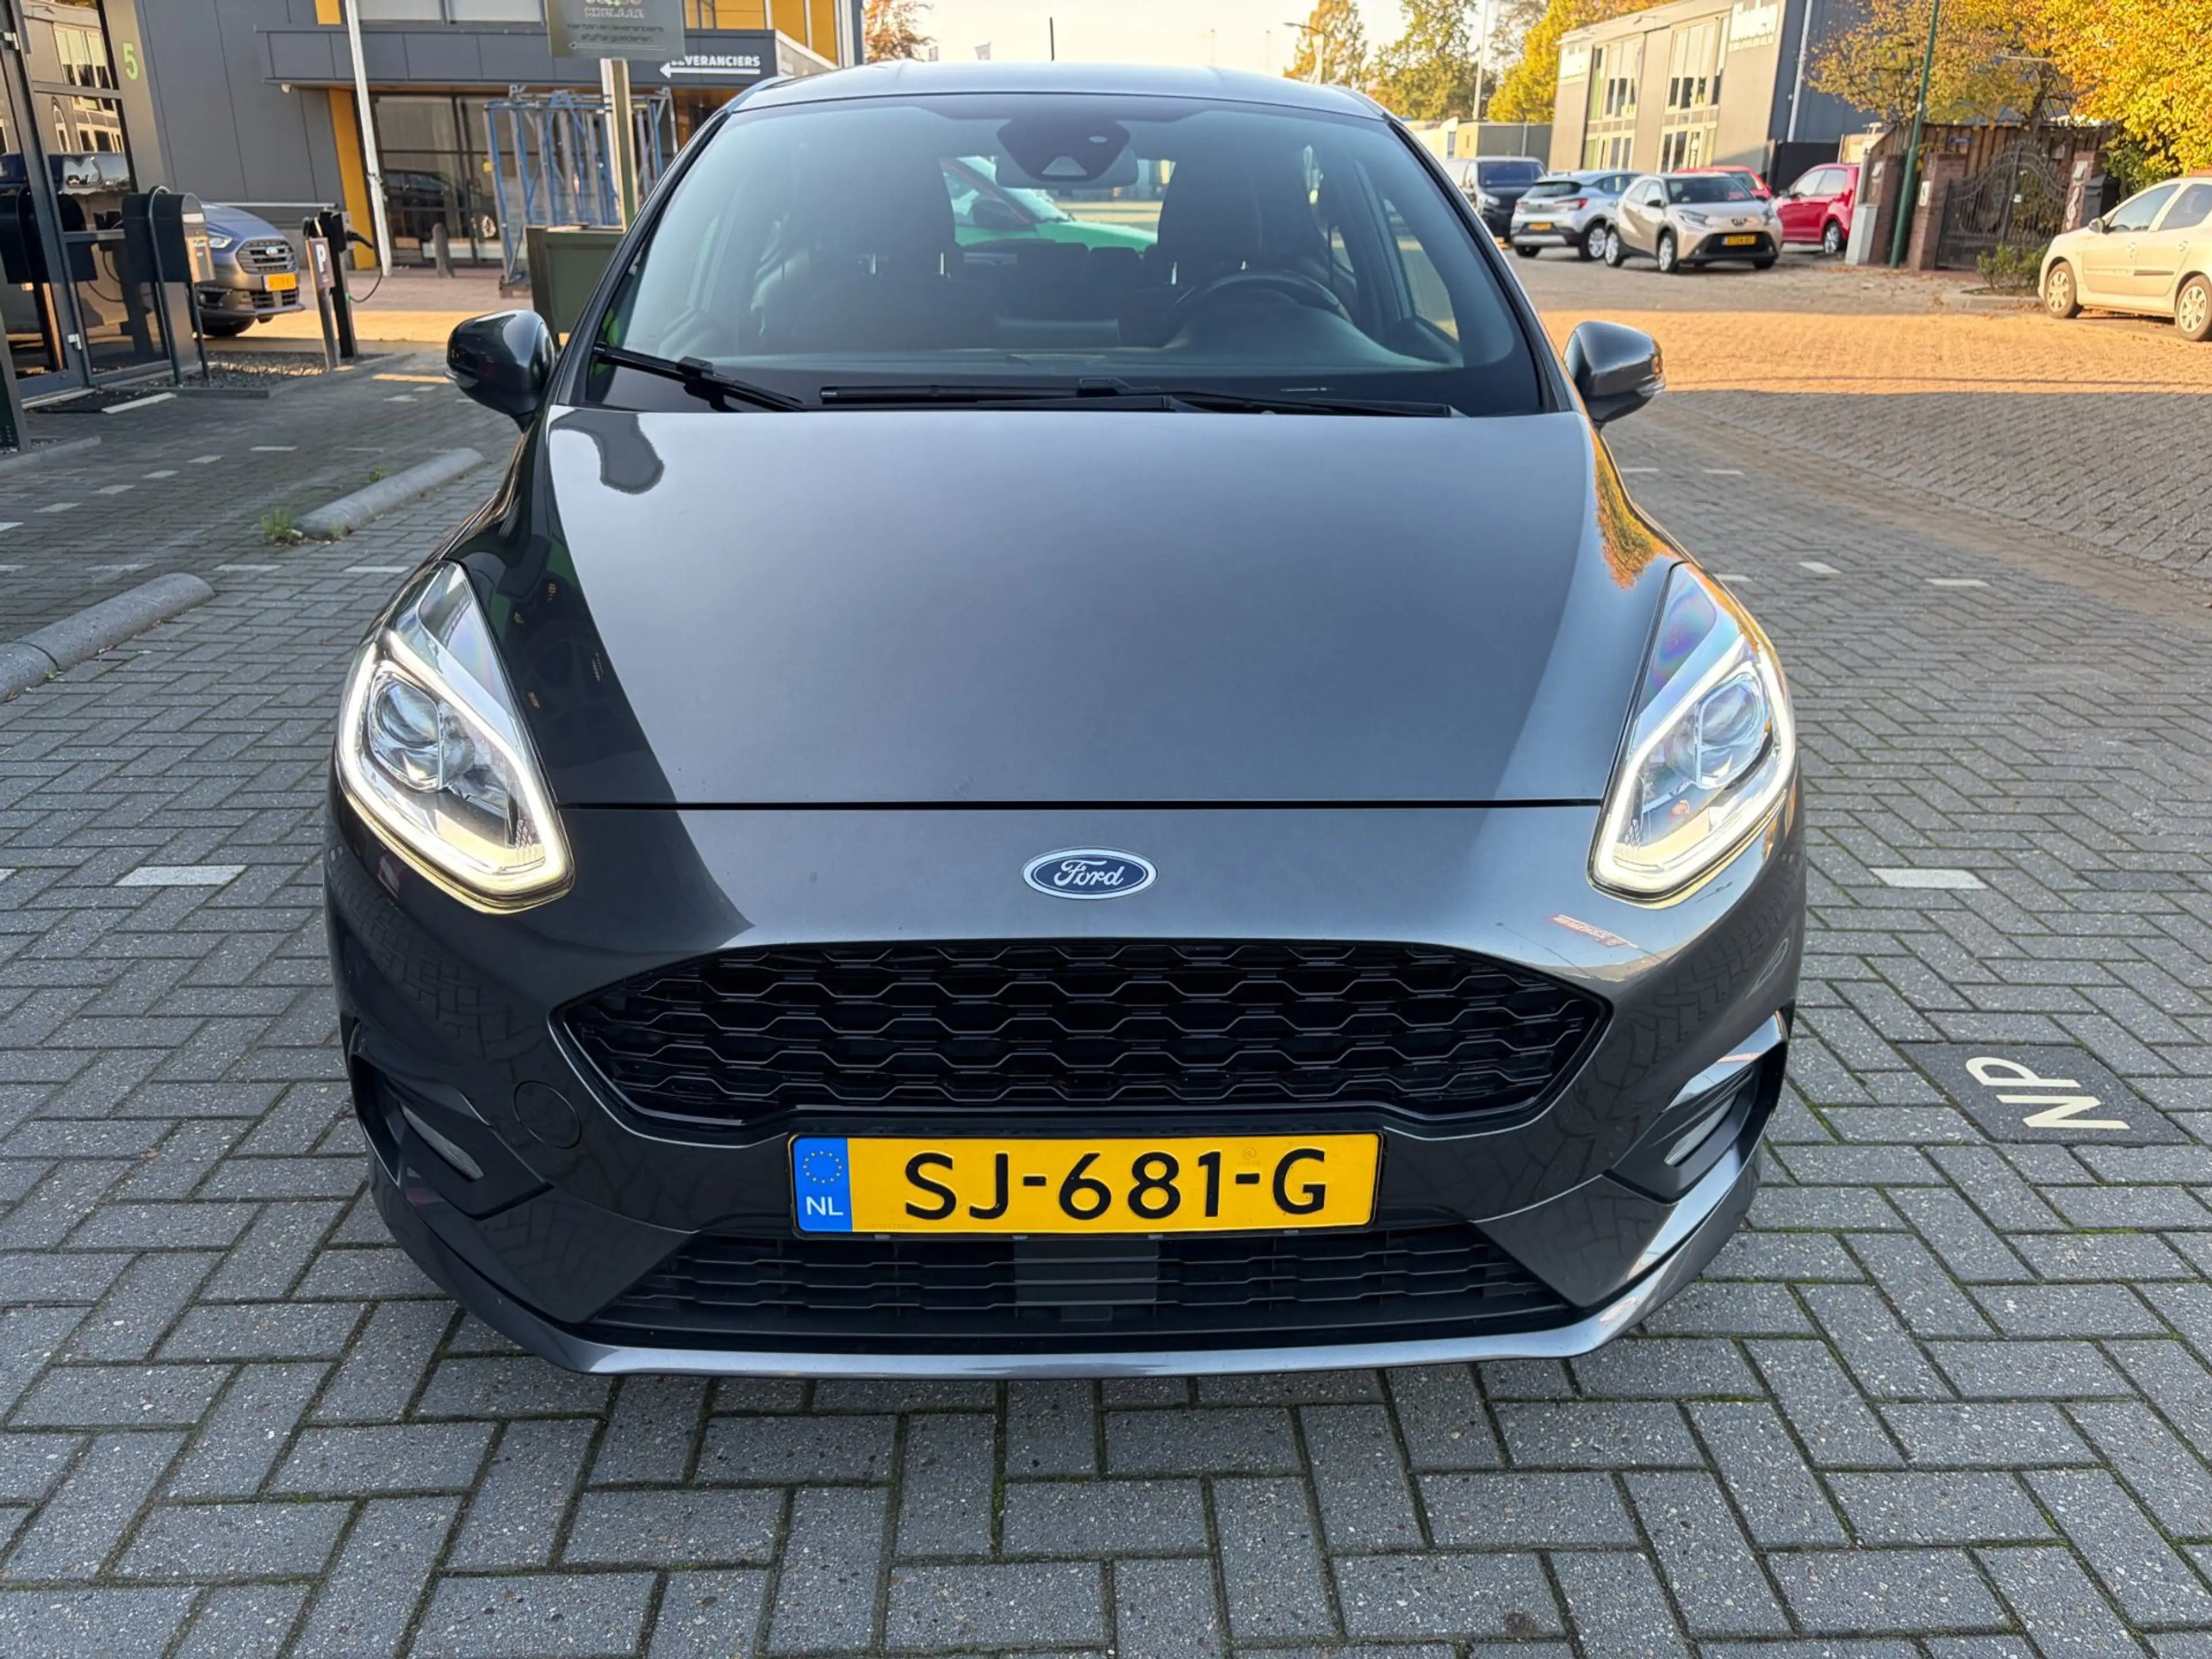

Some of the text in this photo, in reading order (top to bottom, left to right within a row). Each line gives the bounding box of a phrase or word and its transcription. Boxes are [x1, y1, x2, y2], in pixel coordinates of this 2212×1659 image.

[123, 43, 138, 79] 5
[316, 244, 327, 272] P
[1054, 859, 1124, 886] Ford
[1965, 1056, 2131, 1130] NP
[905, 1148, 1326, 1220] SJ-681-G
[806, 1196, 844, 1215] NL
